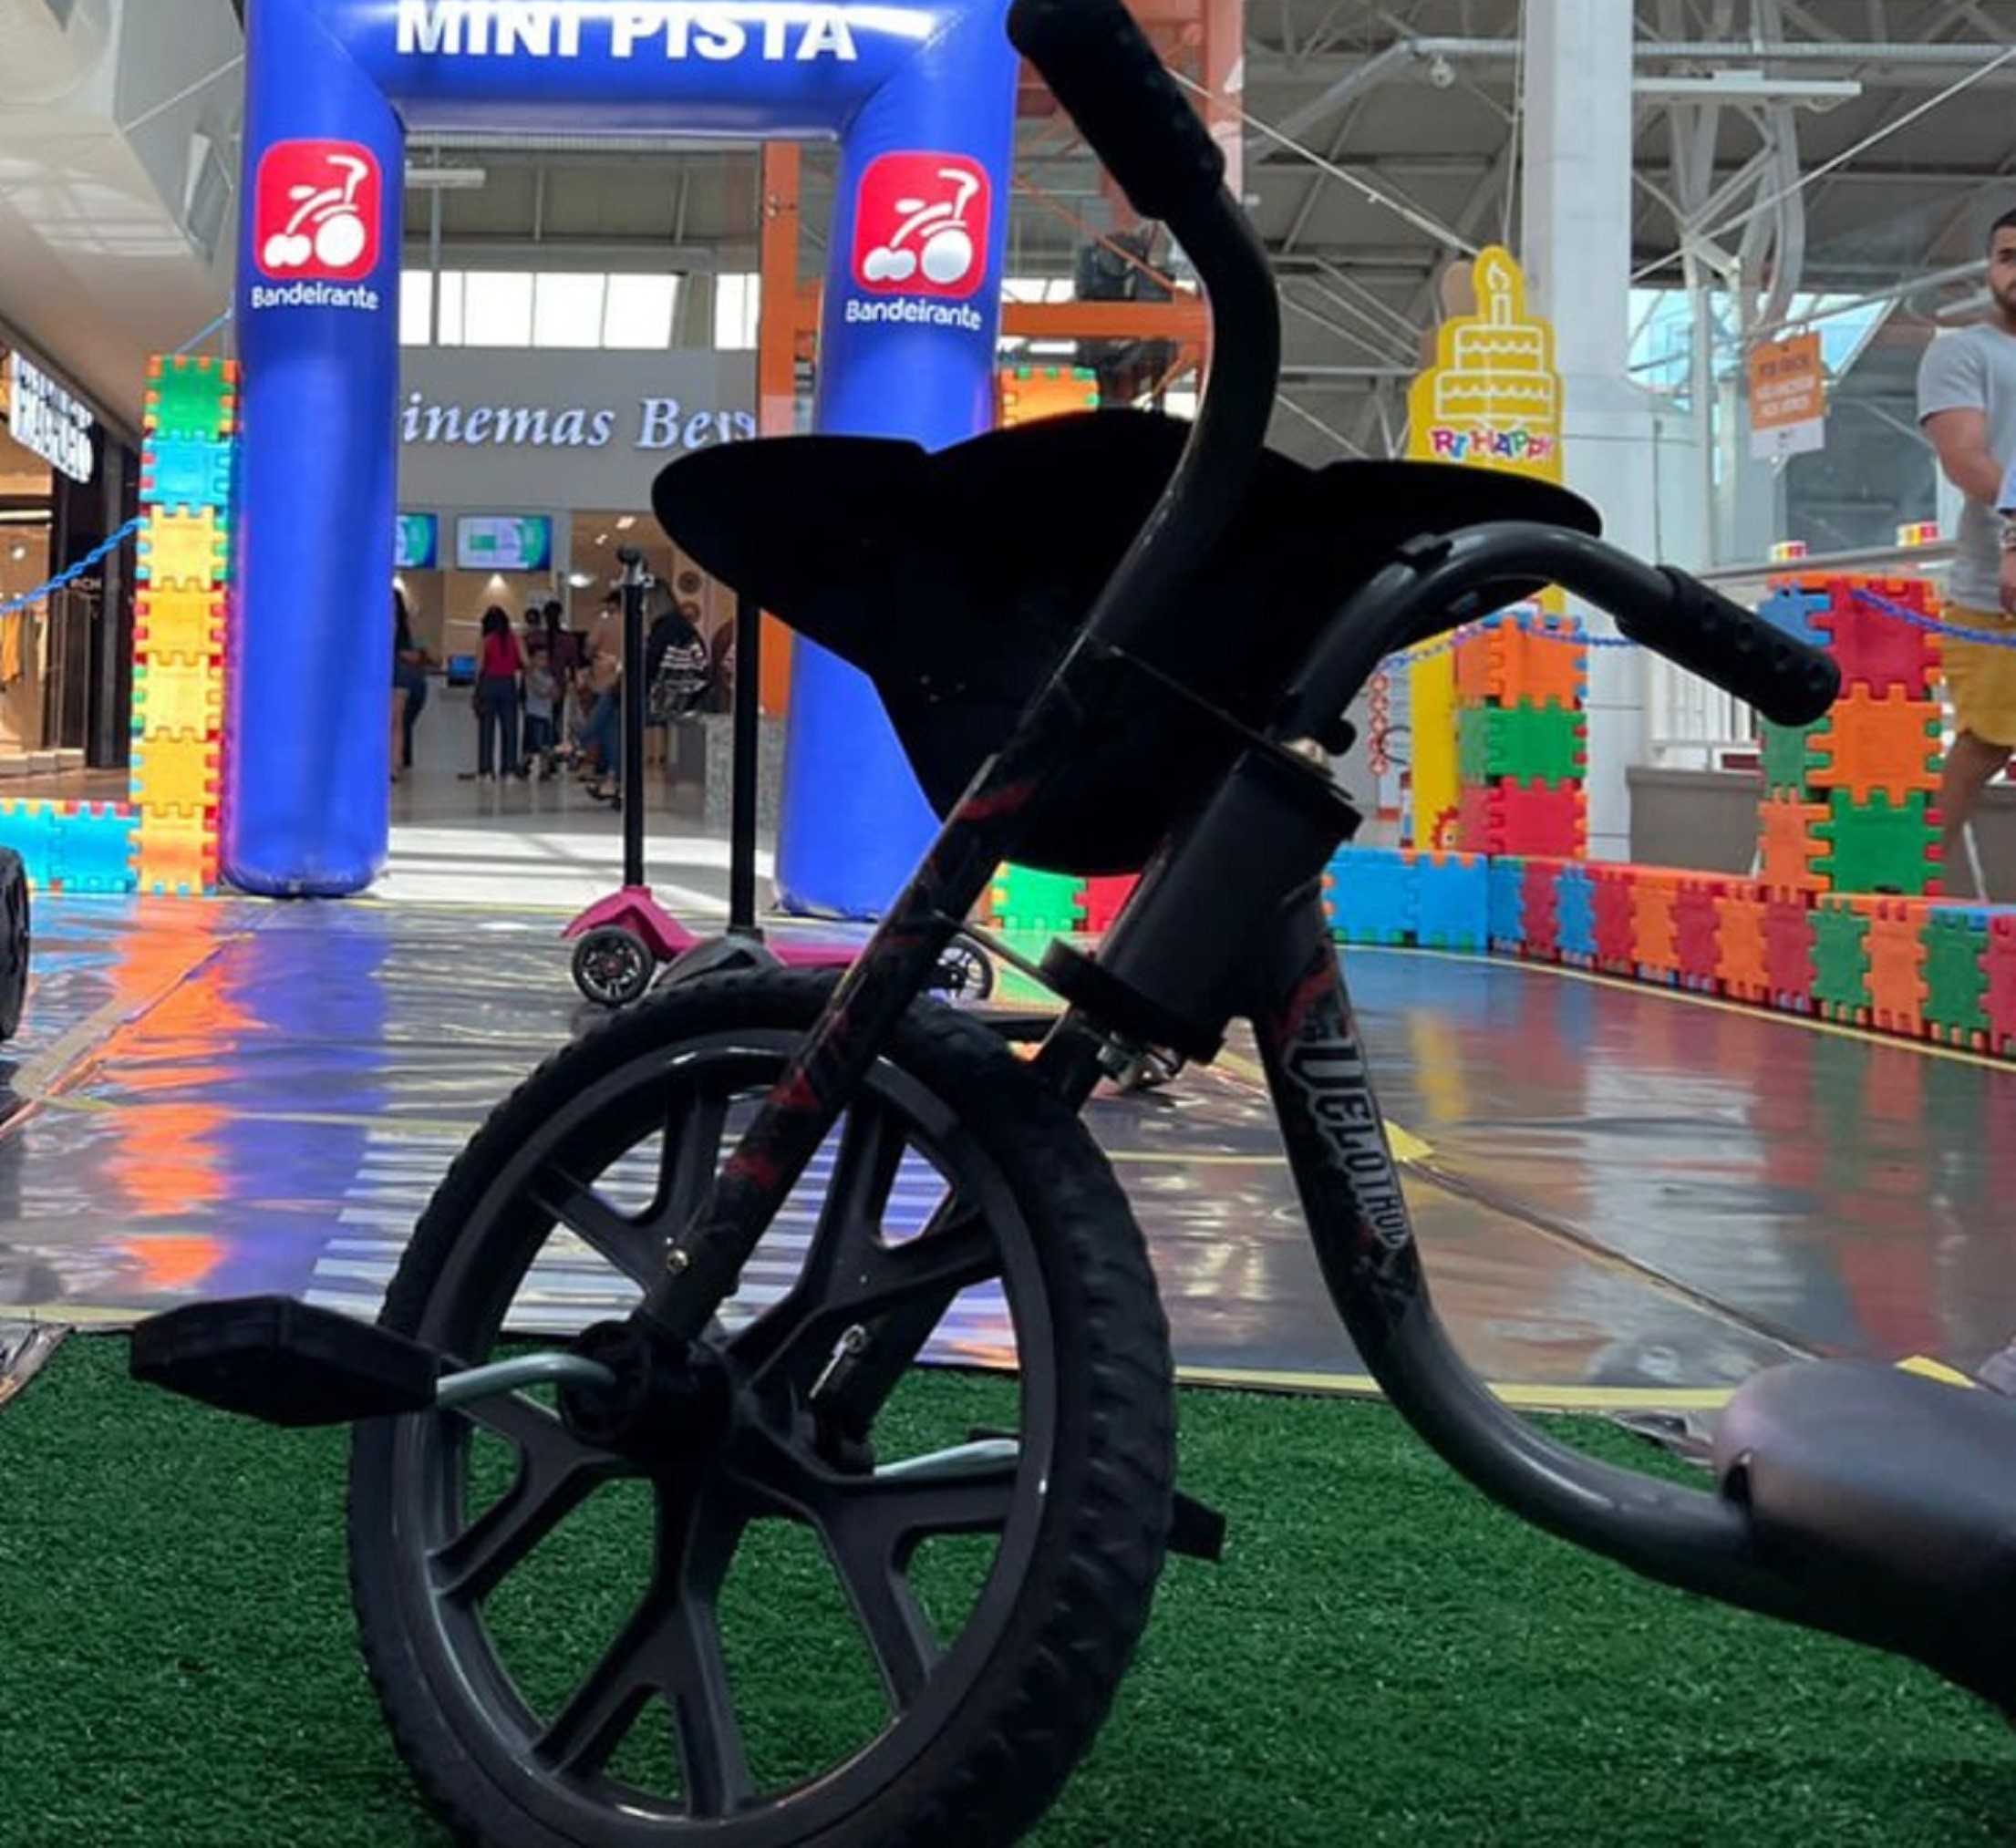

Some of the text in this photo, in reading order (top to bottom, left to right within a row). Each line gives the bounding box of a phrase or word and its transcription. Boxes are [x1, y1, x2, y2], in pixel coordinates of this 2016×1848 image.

[397, 0, 857, 60] MINI PISTA
[251, 282, 379, 310] Bandeirante
[845, 297, 981, 331] Bandeirante
[401, 392, 615, 448] inemas
